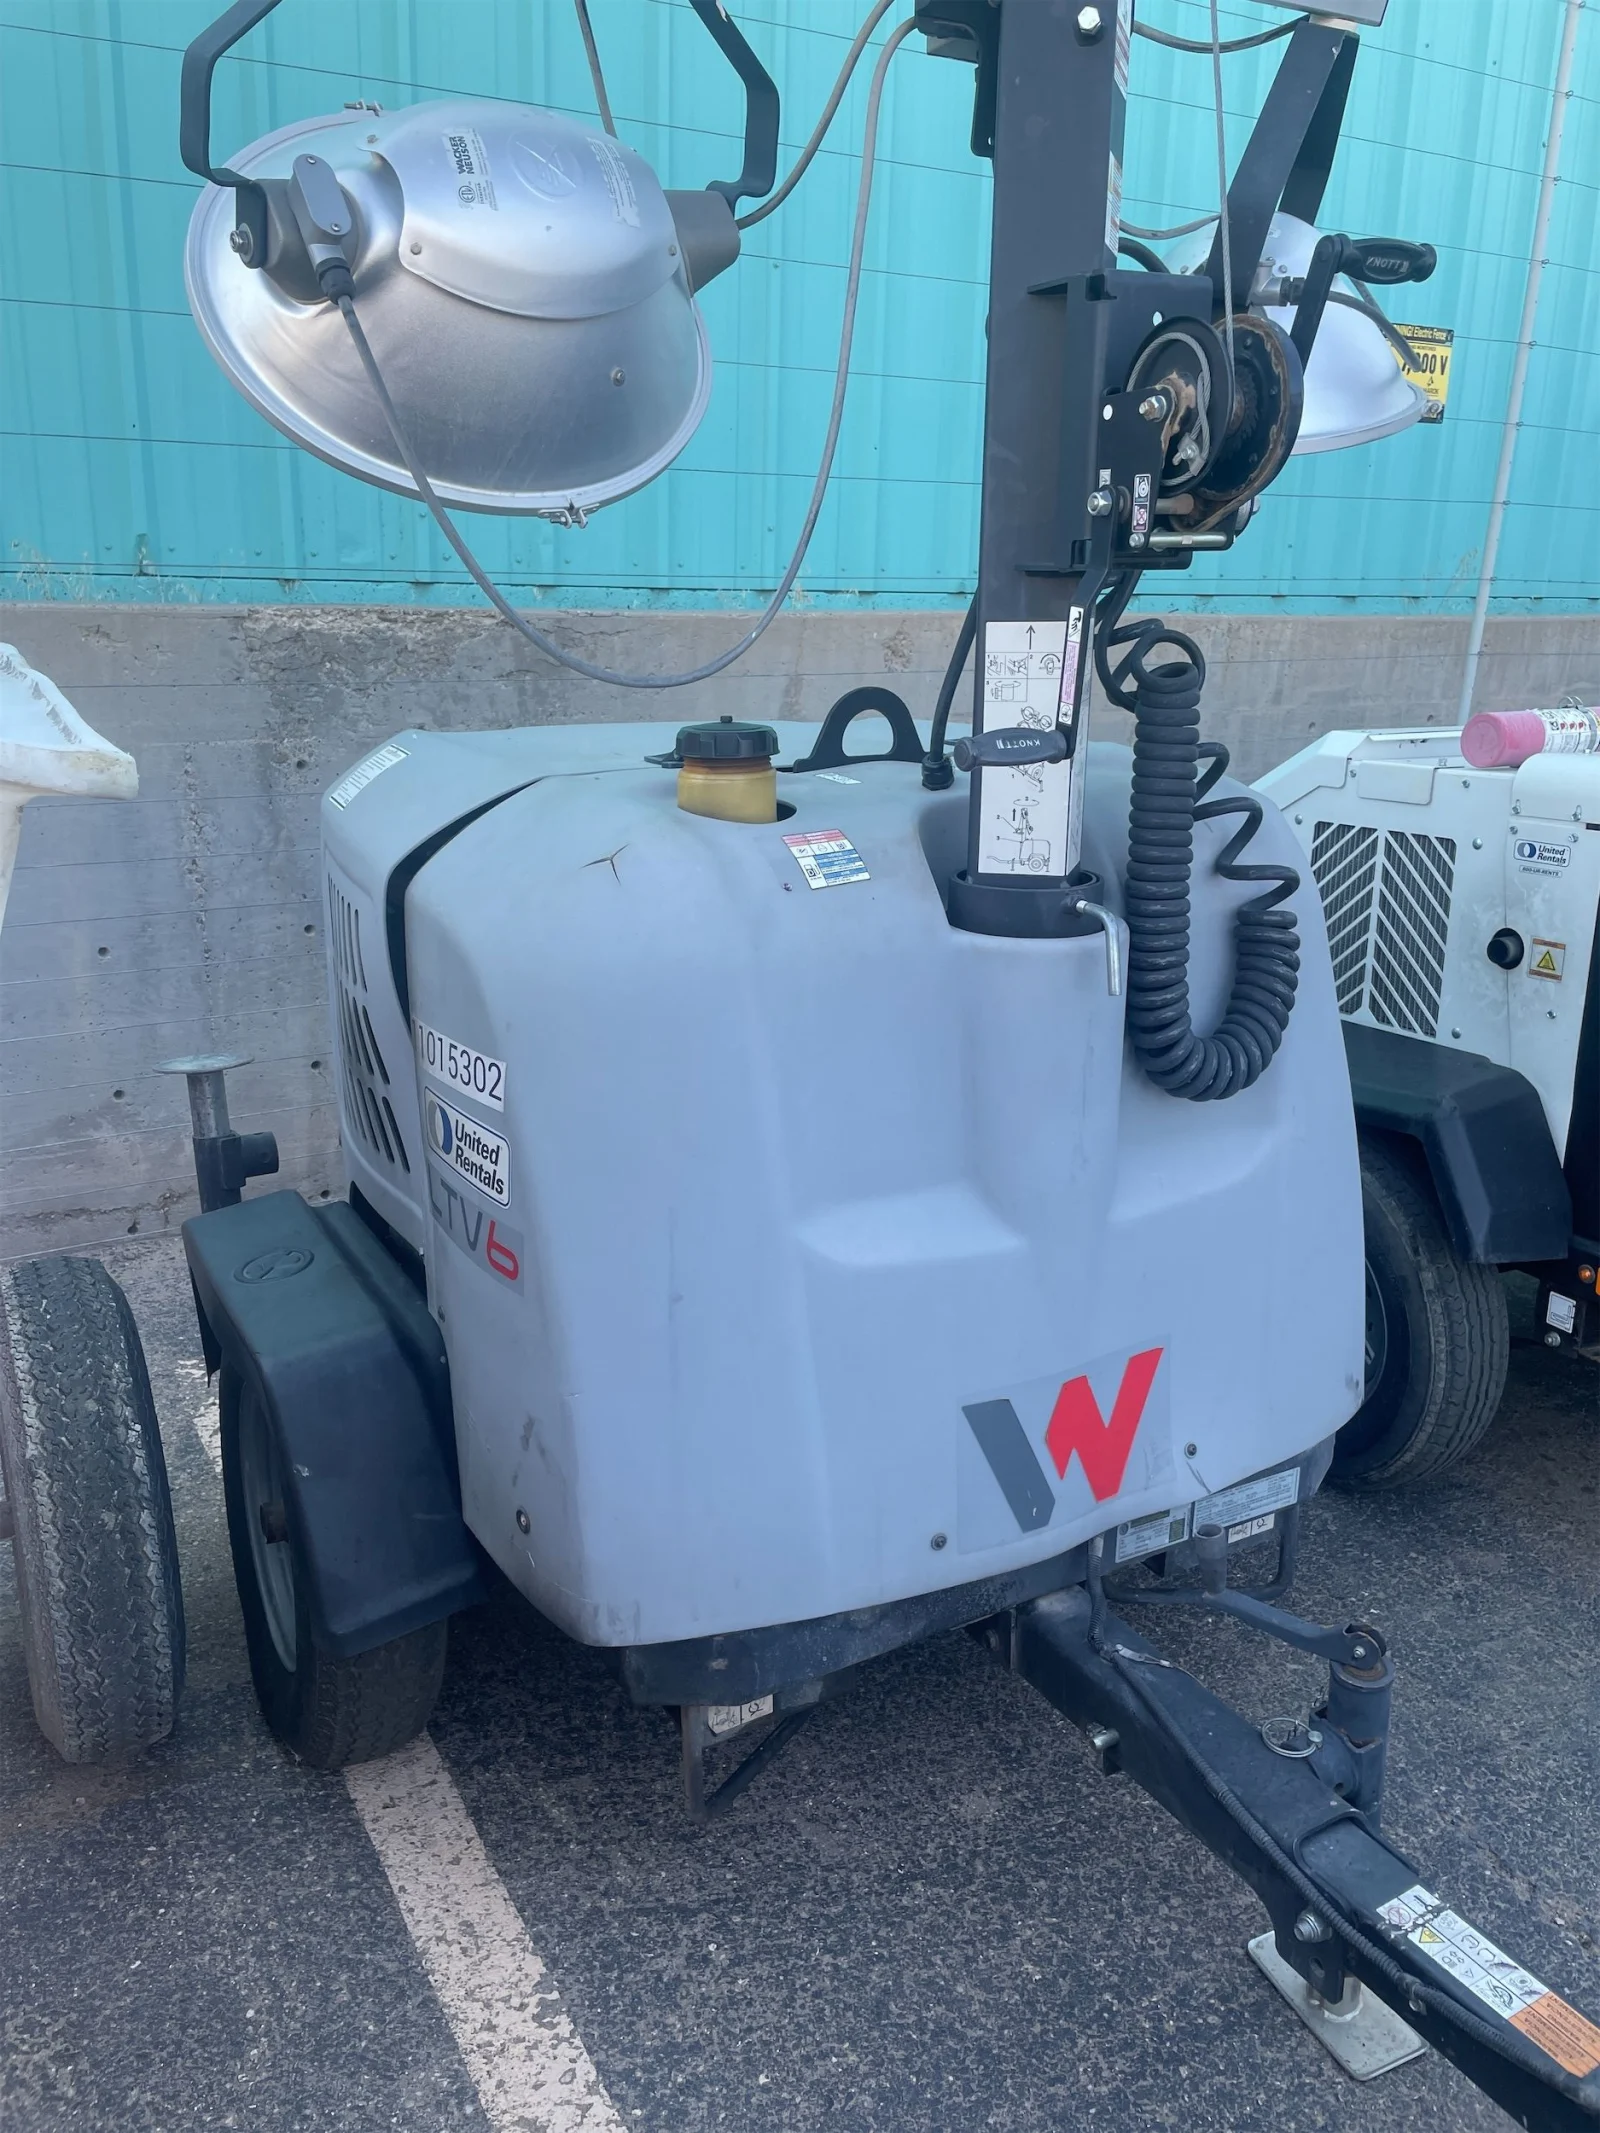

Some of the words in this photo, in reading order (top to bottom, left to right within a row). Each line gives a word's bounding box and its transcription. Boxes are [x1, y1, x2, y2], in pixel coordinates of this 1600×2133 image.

[448, 136, 467, 175] WACKER
[458, 135, 475, 174] NEUSON
[1366, 256, 1401, 270] KNOTT
[1414, 326, 1433, 338] Electric
[1433, 328, 1447, 340] Fence
[1440, 355, 1449, 375] V
[1006, 739, 1041, 749] KNOTT
[1537, 853, 1567, 864] Rentals
[1538, 845, 1566, 856] United
[455, 1119, 501, 1167] United
[455, 1144, 505, 1195] Rentals
[428, 1163, 519, 1281] LTV6
[1547, 2013, 1582, 2042] WARNING
[1525, 2029, 1559, 2058] WARNING
